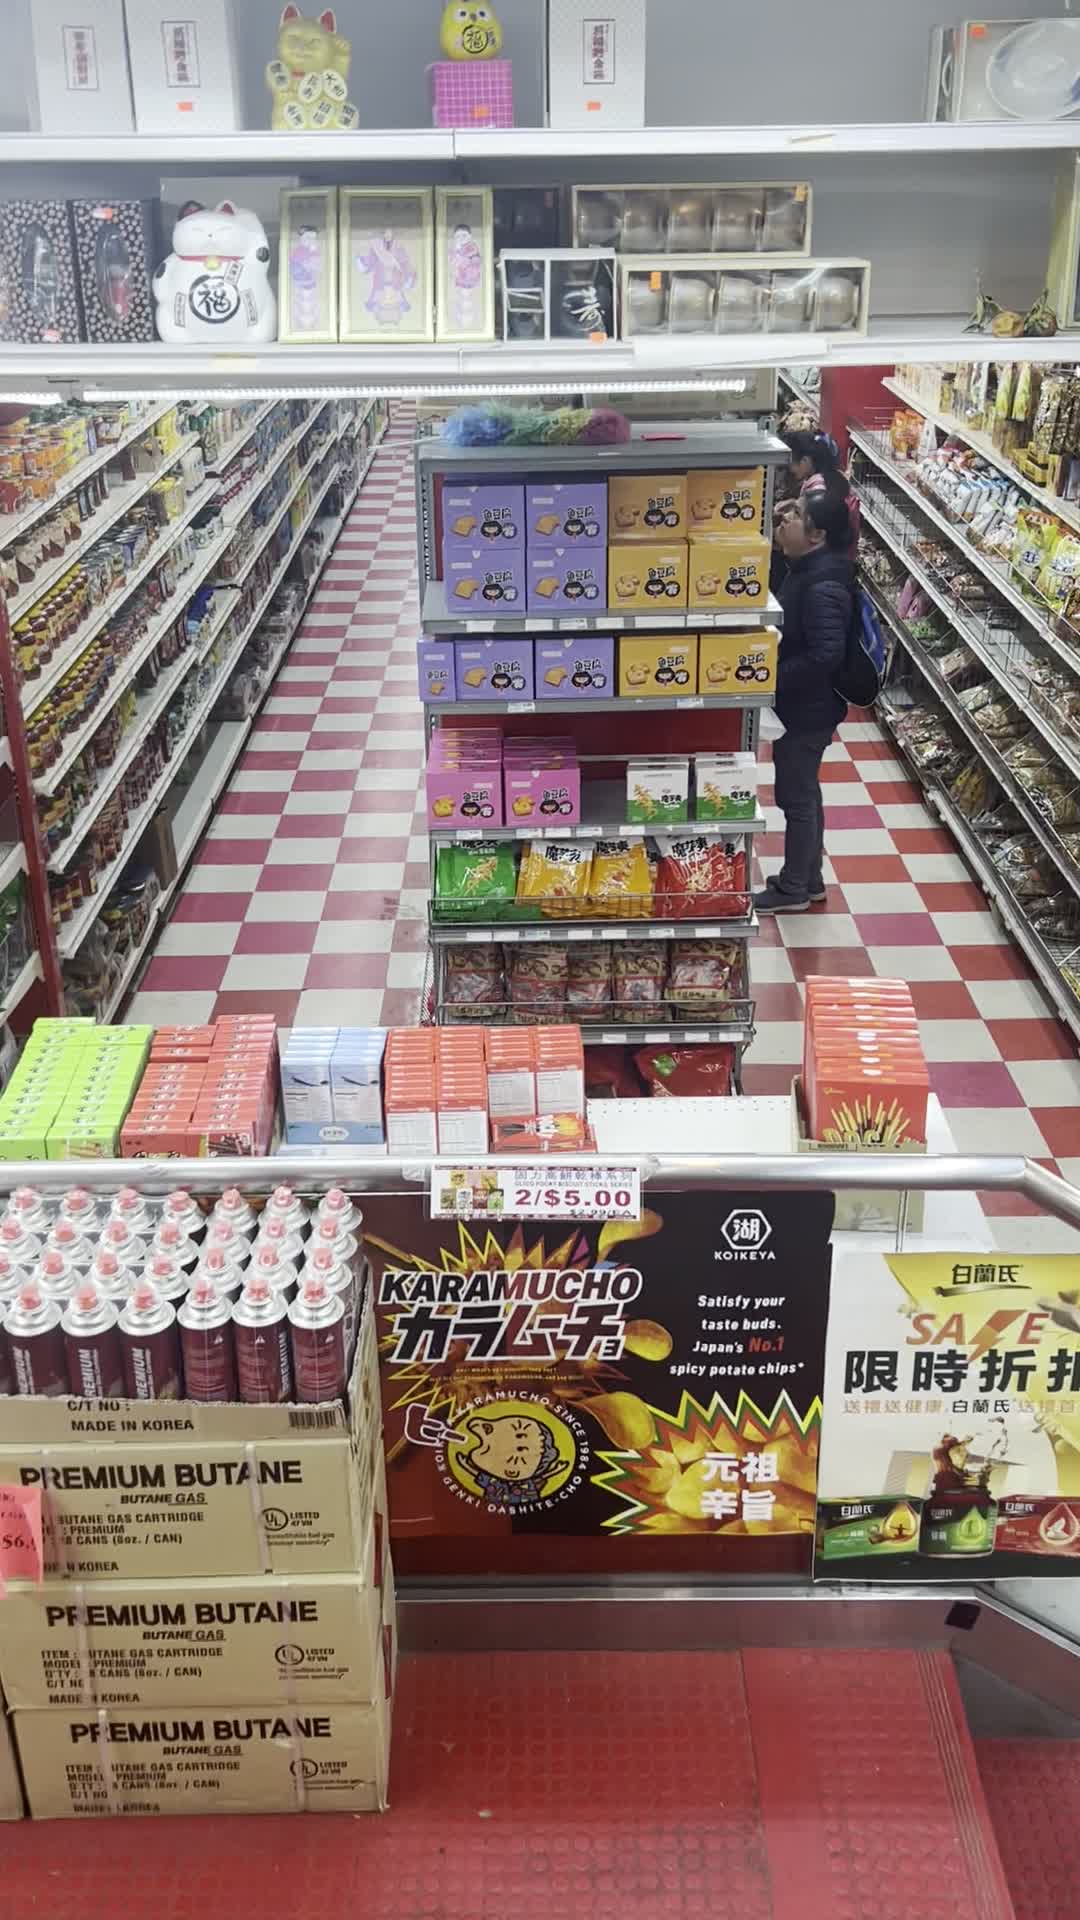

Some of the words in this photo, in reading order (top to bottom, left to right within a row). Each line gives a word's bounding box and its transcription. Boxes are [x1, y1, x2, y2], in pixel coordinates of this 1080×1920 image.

[466, 29, 484, 49] 福
[197, 282, 232, 316] 福
[515, 1189, 632, 1207] 2/$5.00
[732, 1218, 761, 1242] 湖
[714, 1250, 776, 1261] KOIKEYA
[952, 1263, 1021, 1285] 白蘭氏
[379, 1268, 643, 1304] KARAMUCHO
[698, 1295, 751, 1310] Satisfy
[754, 1297, 786, 1310] your
[701, 1318, 740, 1331] taste
[742, 1317, 782, 1330] buds.
[390, 1302, 627, 1363] カラムーチョ
[692, 1340, 744, 1355] Japan's
[748, 1336, 785, 1353] No.1
[670, 1362, 706, 1376] spicy
[709, 1362, 756, 1377] potato
[67, 1400, 96, 1412] C/T
[98, 1402, 120, 1412] NO
[71, 1420, 117, 1433] MADE
[120, 1420, 138, 1432] IN
[142, 1418, 195, 1432] KOREA
[701, 1451, 780, 1483] 元祖
[20, 1464, 166, 1490] PREMIUM
[174, 1460, 303, 1488] BUTANE
[120, 1494, 173, 1505] BUTANE
[174, 1493, 207, 1504] GAS
[700, 1488, 777, 1521] 辛旨
[107, 1513, 133, 1524] GAS
[136, 1511, 205, 1523] CARTRIDGE
[70, 1525, 125, 1535] PREMIUM
[76, 1535, 108, 1545] CANS
[153, 1533, 183, 1545] CAN)
[78, 1562, 119, 1572] KOREA
[195, 1600, 318, 1625] BUTANE
[142, 1631, 192, 1641] BUTANE
[195, 1629, 226, 1641] GAS
[41, 1650, 70, 1659] ITEM
[89, 1649, 126, 1659] UTANE
[129, 1648, 153, 1658] GAS
[157, 1647, 223, 1658] CARTRIDGE
[94, 1658, 146, 1668] PREMIUM
[100, 1668, 130, 1678] CANS
[174, 1666, 202, 1677] CAN)
[49, 1694, 83, 1704] MADE
[101, 1693, 140, 1703] KOREA
[213, 1717, 332, 1742] BUTANE
[162, 1746, 211, 1756] BUTANE
[213, 1745, 243, 1756] GAS
[112, 1763, 148, 1773] UTANE
[150, 1762, 174, 1772] GAS
[176, 1761, 241, 1772] CARTRIDGE
